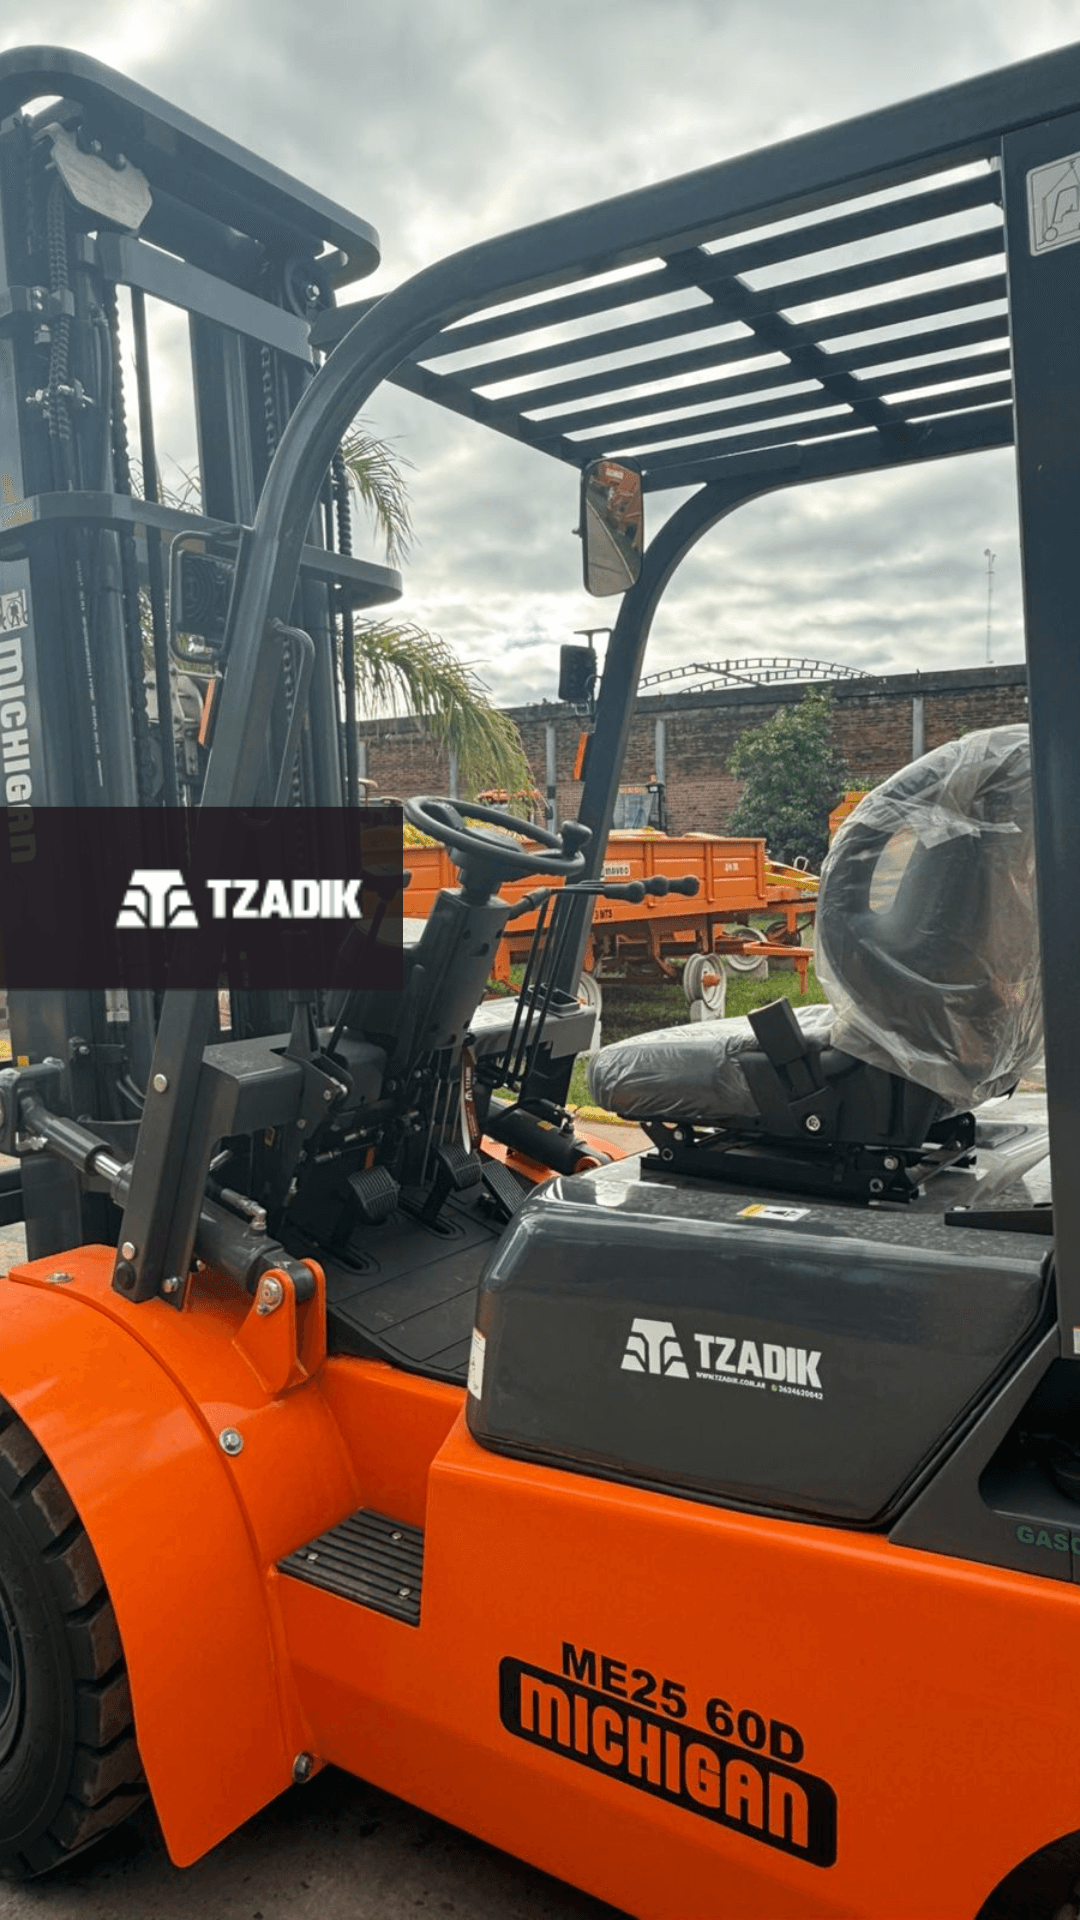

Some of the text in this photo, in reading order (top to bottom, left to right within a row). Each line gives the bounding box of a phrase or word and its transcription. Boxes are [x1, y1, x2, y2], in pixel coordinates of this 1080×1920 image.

[694, 1333, 822, 1388] TZADIK
[519, 1672, 809, 1849] MICHIGAN
[562, 1641, 804, 1764] ME25 60D
